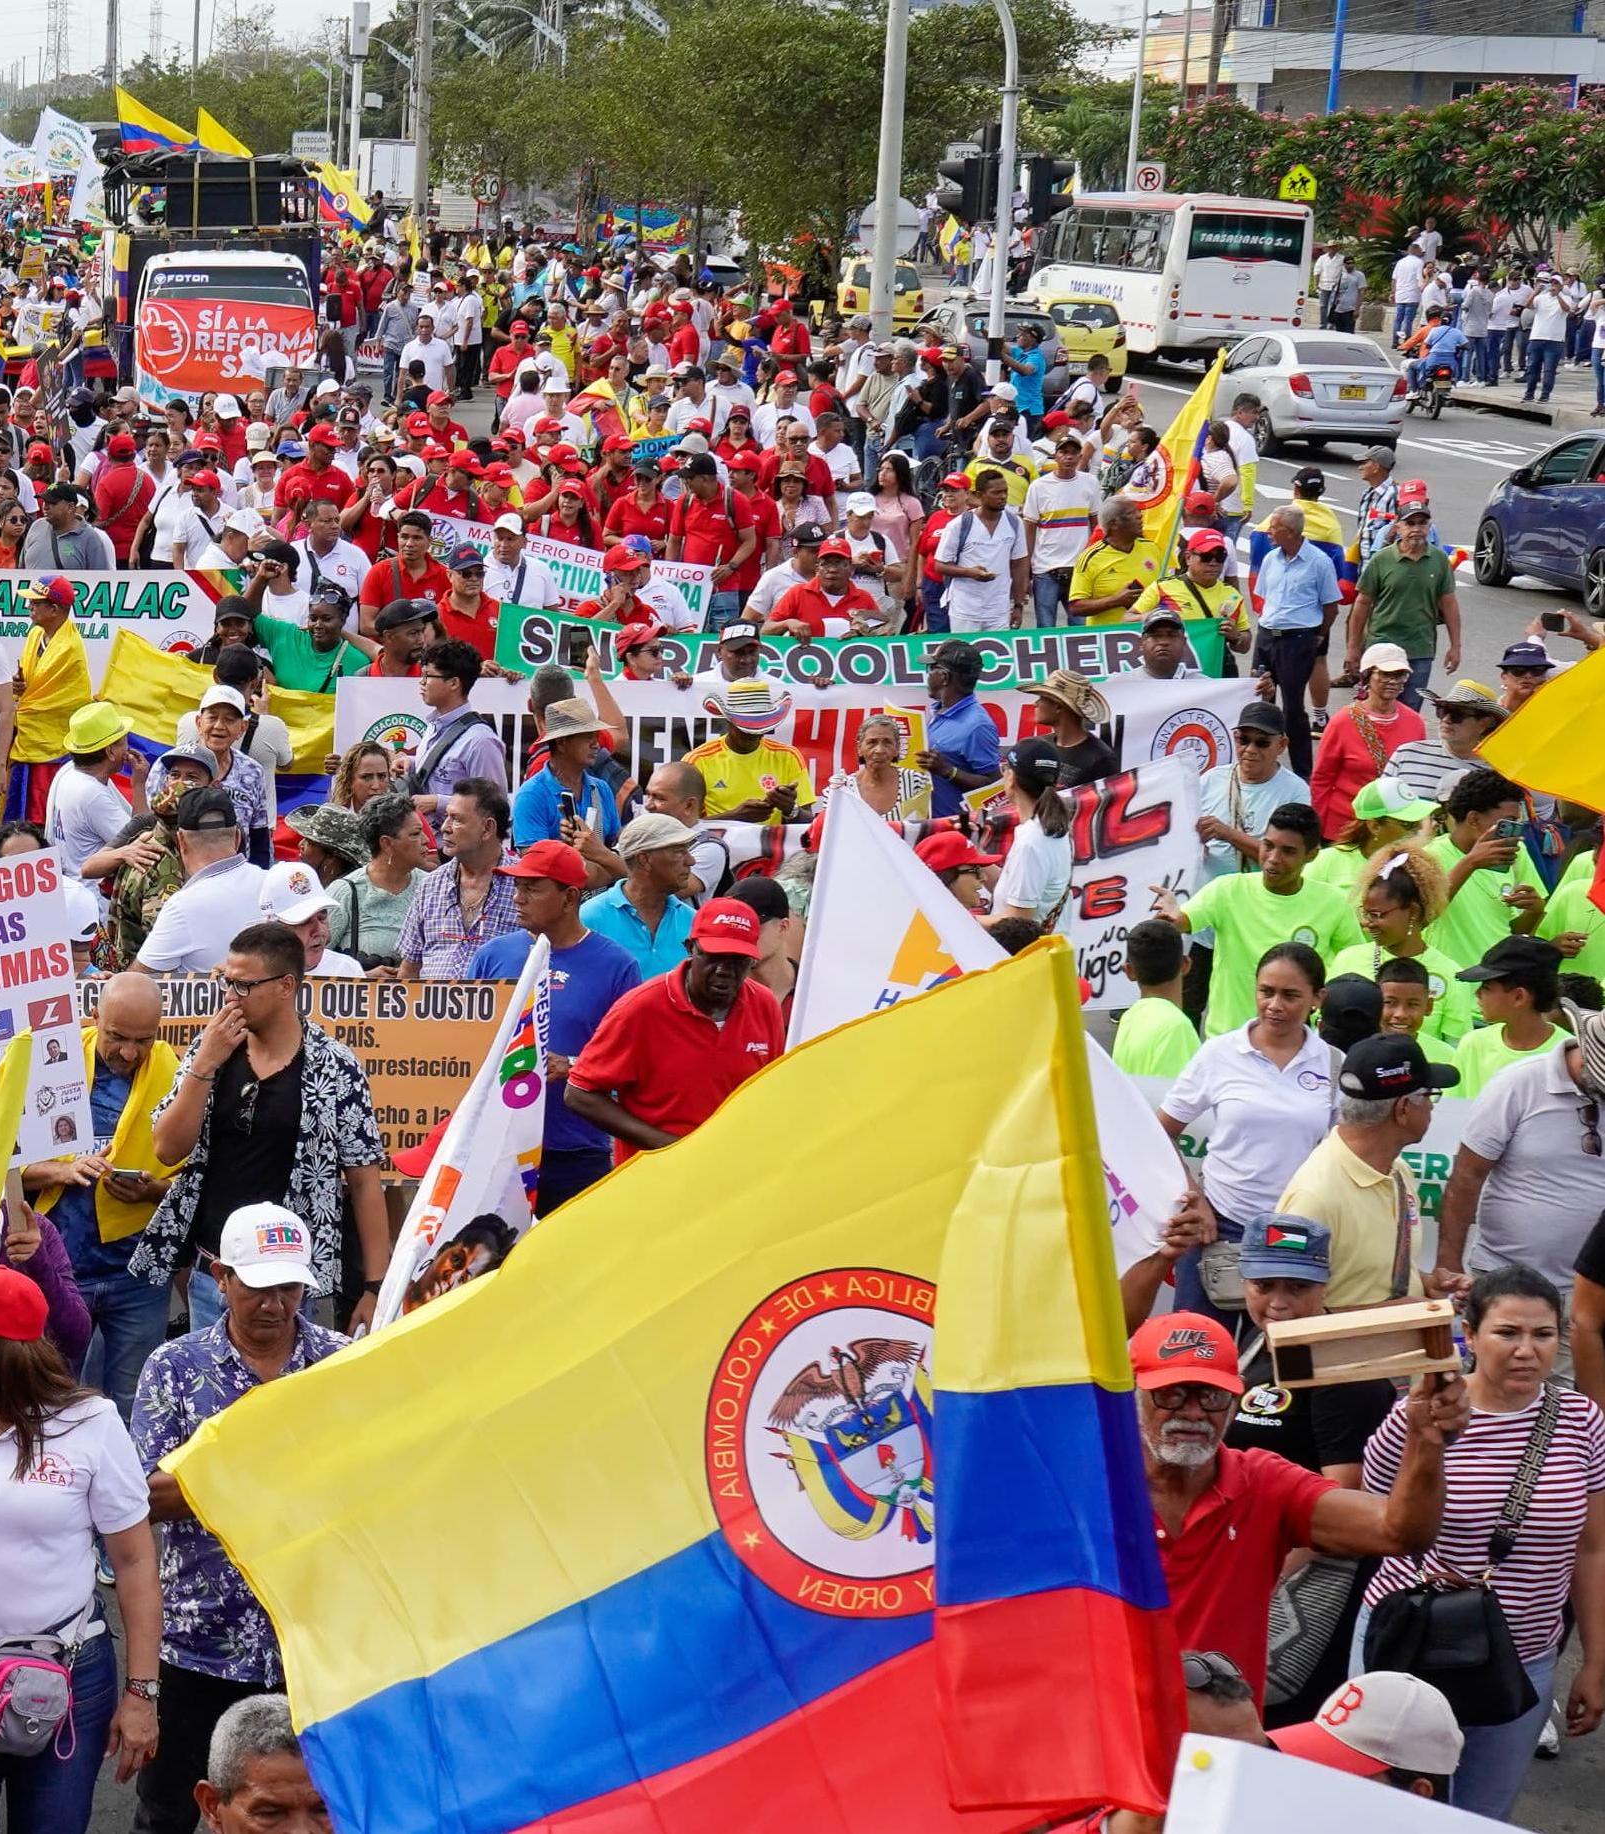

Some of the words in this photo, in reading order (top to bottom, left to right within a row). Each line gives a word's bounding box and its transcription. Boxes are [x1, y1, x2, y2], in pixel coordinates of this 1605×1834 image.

[166, 273, 210, 283] FOTON
[197, 305, 223, 330] SÍ
[225, 318, 239, 330] A
[245, 316, 268, 330] LA
[195, 326, 314, 351] REFORMA
[194, 353, 203, 362] A
[205, 354, 218, 362] LA
[1156, 712, 1228, 752] SINALTRALAC
[322, 983, 370, 1021] QUE
[377, 983, 406, 1019] ES
[414, 984, 496, 1021] JUSTO
[336, 1022, 380, 1048] PAÍS.
[365, 1056, 472, 1079] prestación
[61, 1087, 82, 1096] JUSTA
[416, 1109, 428, 1126] a
[256, 1227, 302, 1246] PETRO
[1167, 1329, 1210, 1345] NIKE
[1195, 1347, 1216, 1359] SB
[1235, 1412, 1283, 1427] Atlántico
[28, 1473, 67, 1485] ADEA
[1320, 1683, 1365, 1726] B
